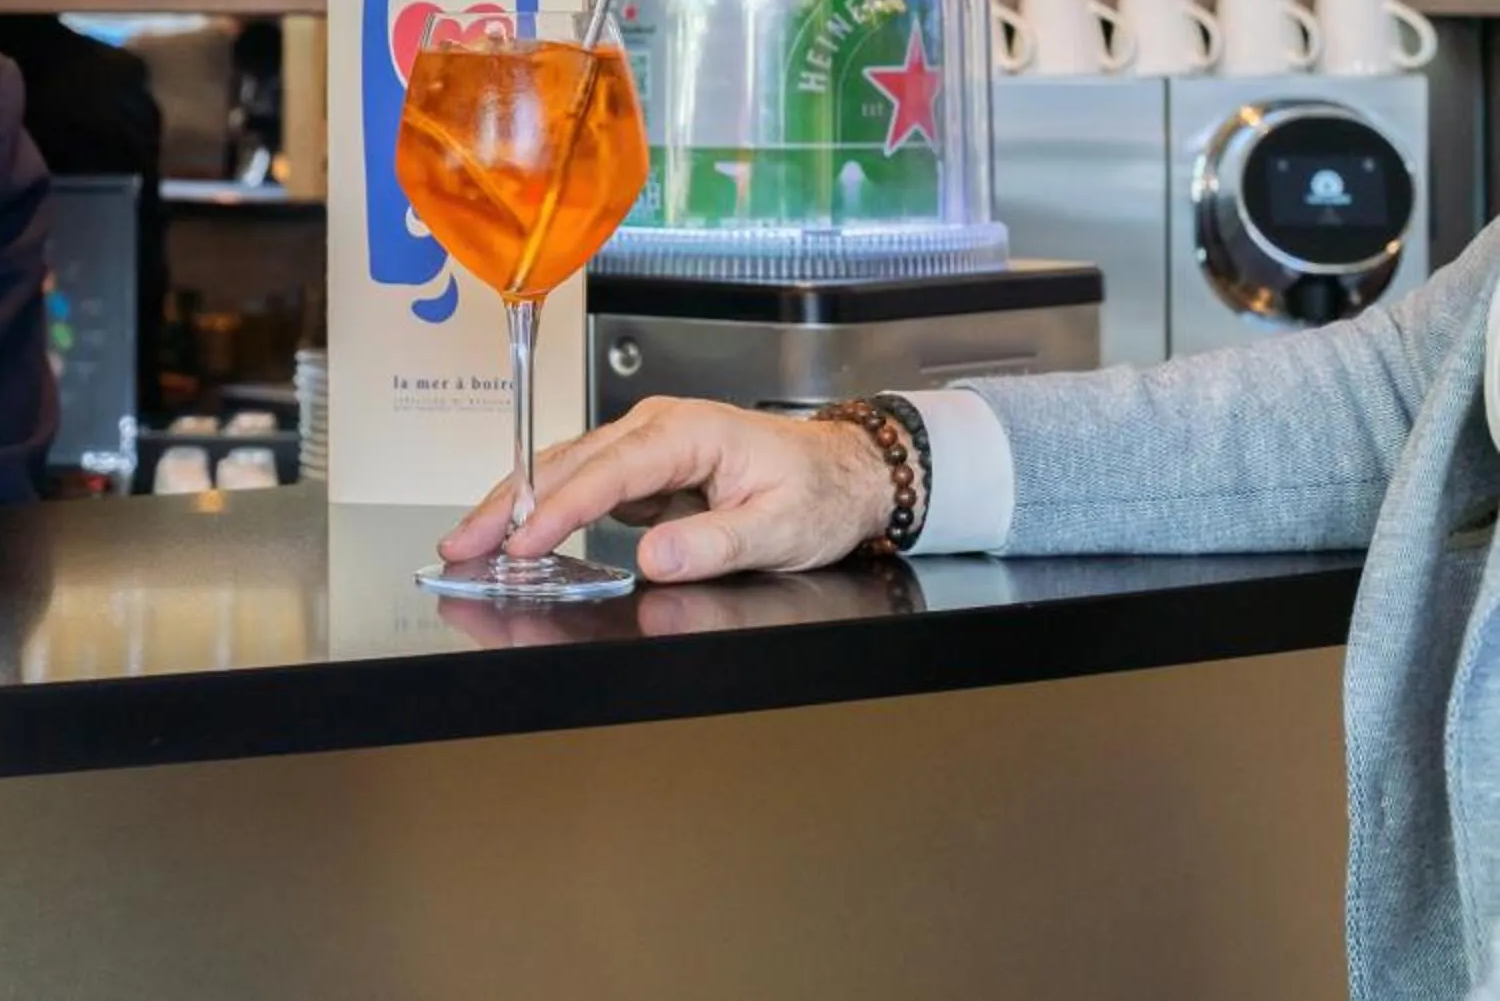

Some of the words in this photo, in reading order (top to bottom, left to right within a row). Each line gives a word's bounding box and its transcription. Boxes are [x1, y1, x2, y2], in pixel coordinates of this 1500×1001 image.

[392, 374, 409, 390] la
[415, 379, 449, 390] mer
[455, 376, 464, 390] à
